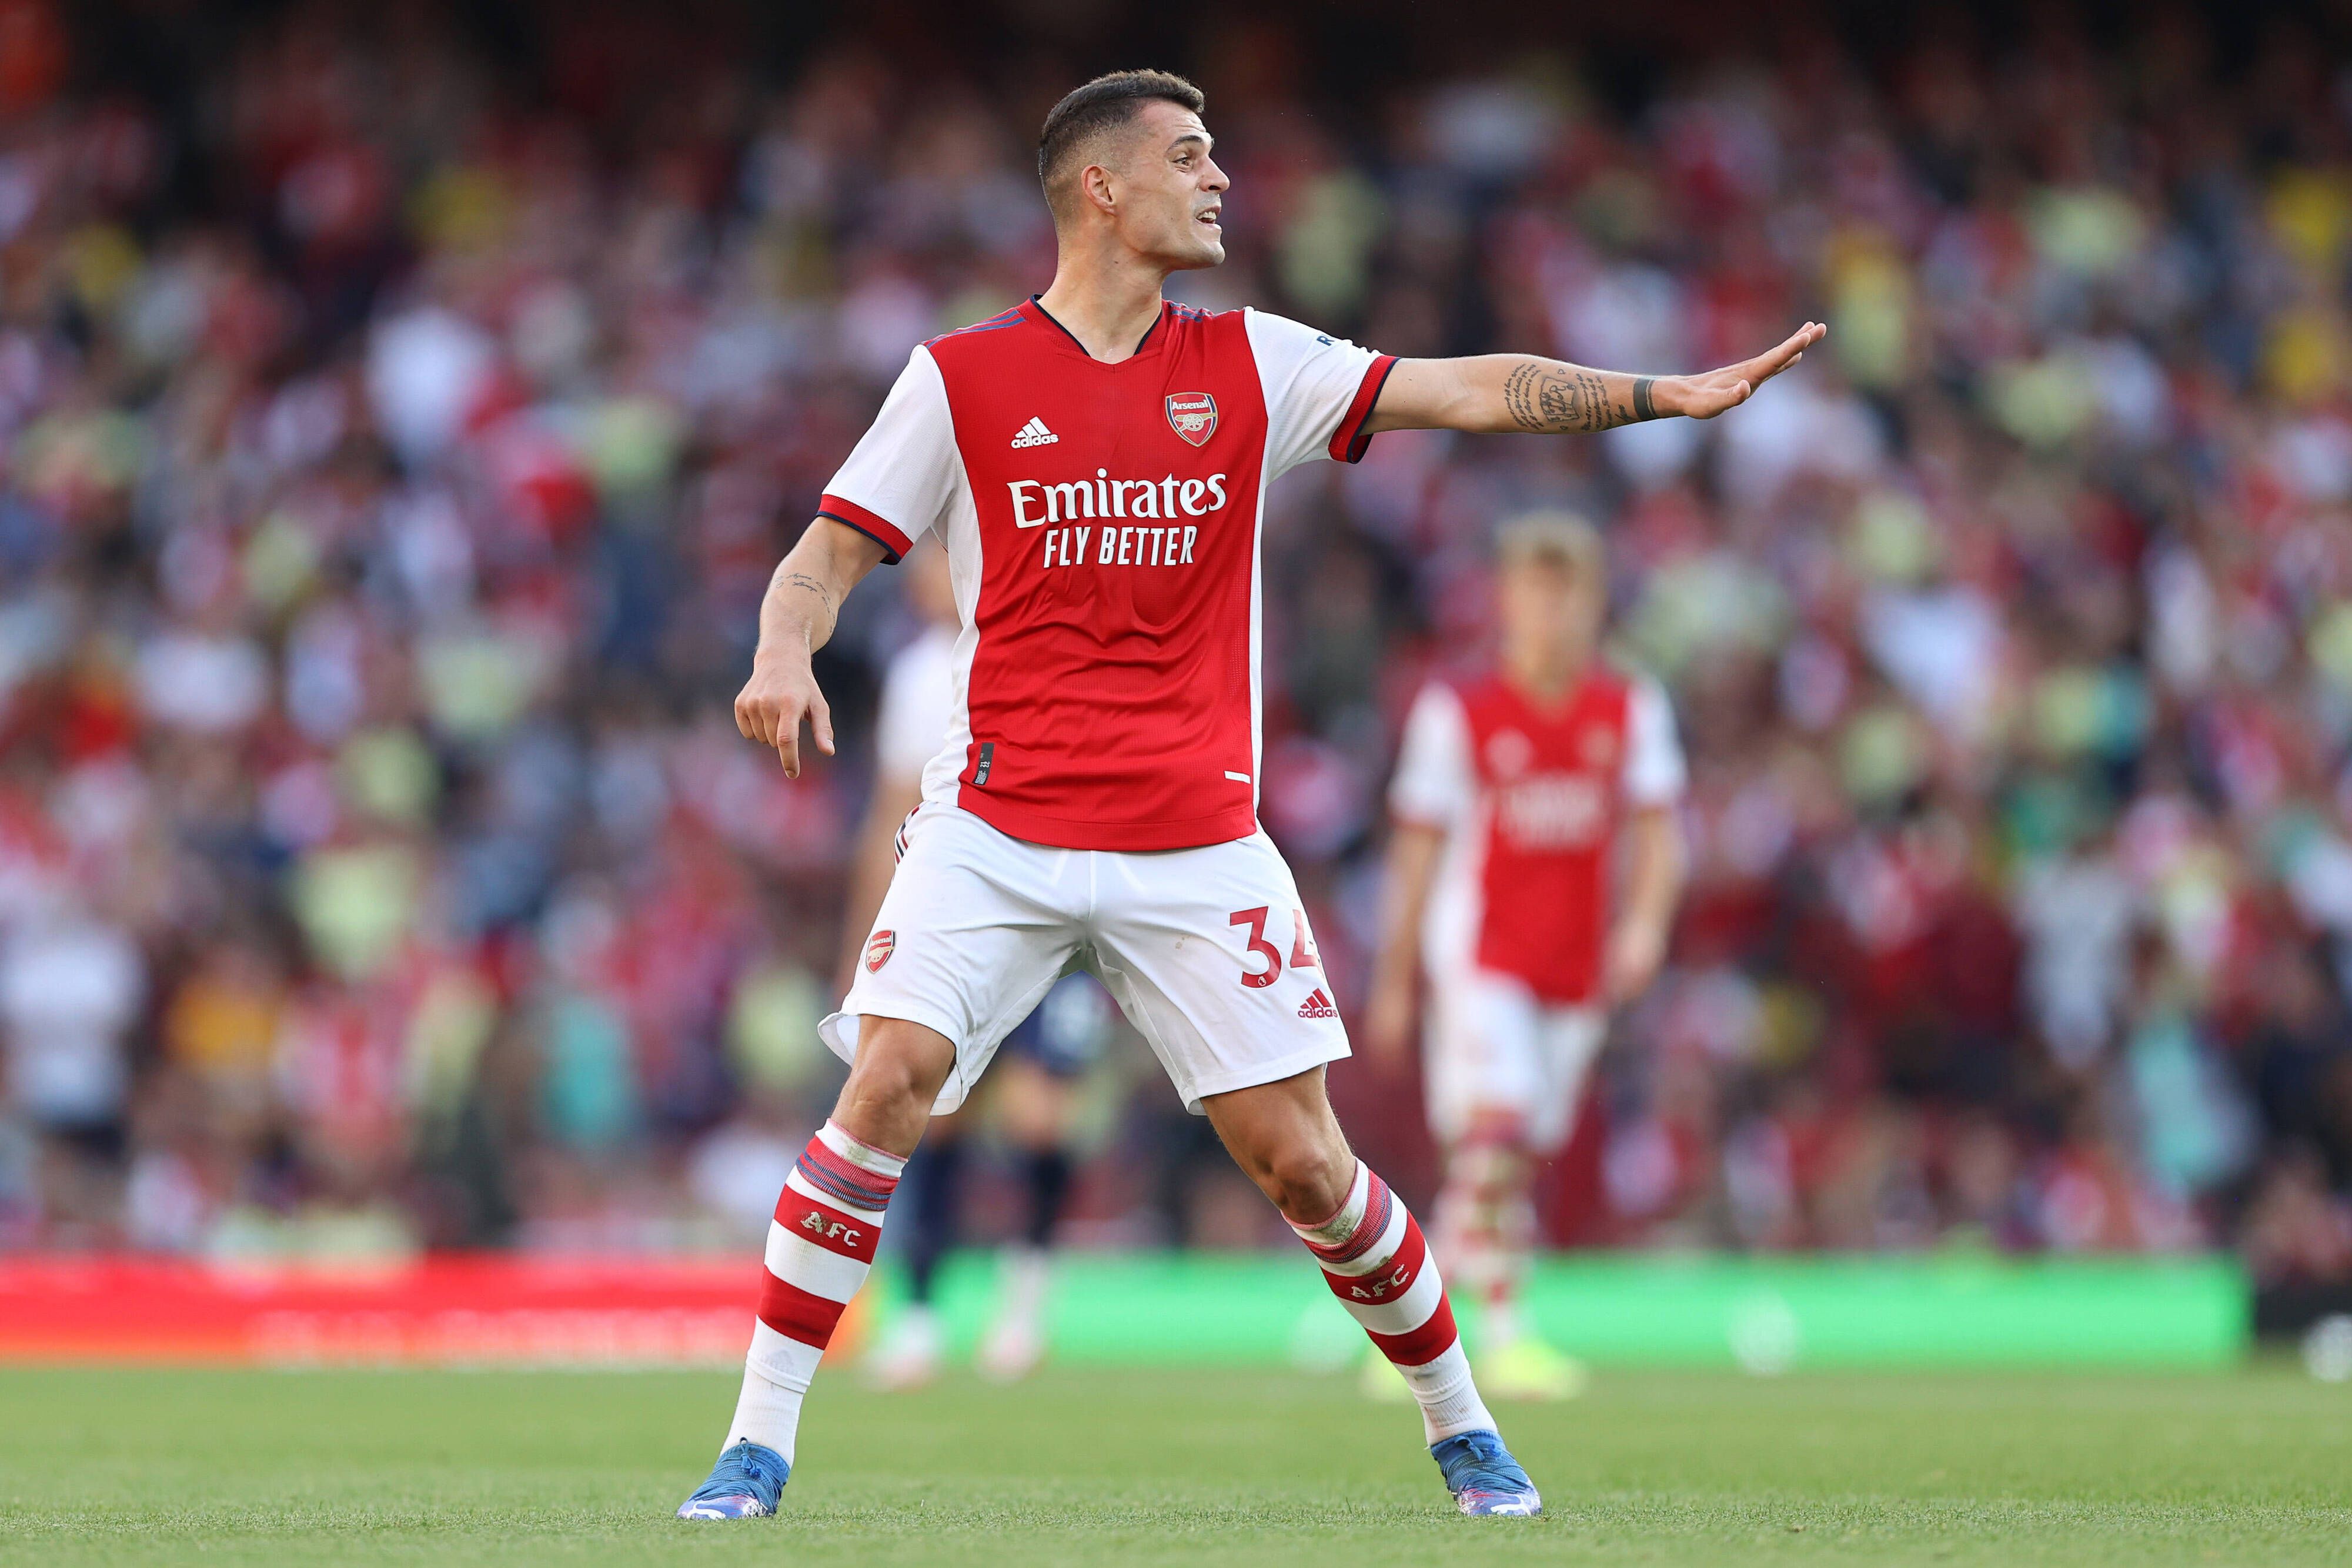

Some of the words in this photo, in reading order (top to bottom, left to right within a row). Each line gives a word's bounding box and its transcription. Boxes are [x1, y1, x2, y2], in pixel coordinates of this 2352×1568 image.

[1172, 399, 1209, 410] Arsenal
[1011, 433, 1058, 449] adidas
[1007, 468, 1227, 529] Emirates
[1043, 527, 1091, 569] FLY
[1098, 526, 1197, 566] BETTER
[1230, 906, 1324, 988] 34
[1298, 1008, 1338, 1018] adidas
[800, 1211, 861, 1247] AFC
[1351, 1264, 1409, 1298] AFC
